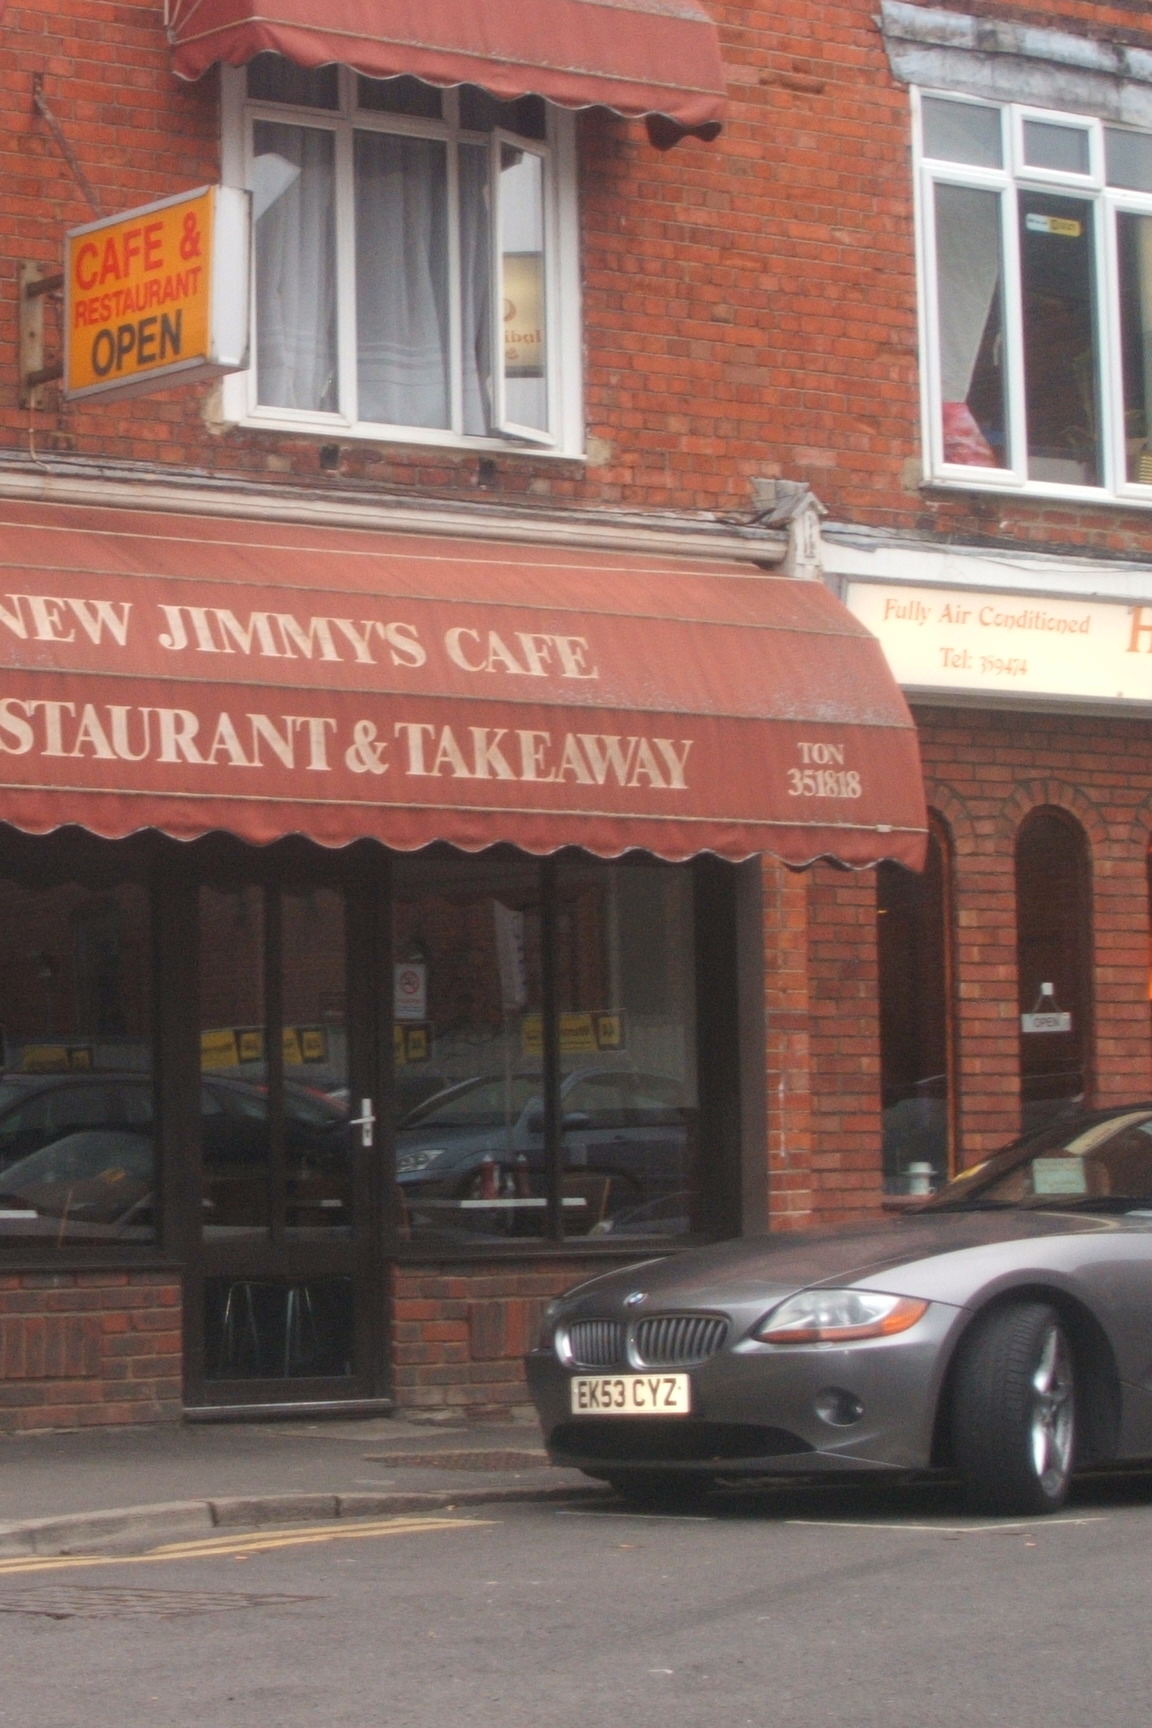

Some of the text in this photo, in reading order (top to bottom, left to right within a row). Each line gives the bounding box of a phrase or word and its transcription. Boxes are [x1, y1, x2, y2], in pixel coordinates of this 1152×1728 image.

[74, 211, 202, 291] CAFE &
[74, 266, 202, 329] RESTAURANT
[91, 309, 183, 377] OPEN
[882, 598, 1091, 635] Fully Air Conditioned
[157, 604, 427, 668] JIMMY'S
[444, 626, 600, 680] CAFE
[939, 646, 973, 669] Tel:
[345, 719, 390, 776] &
[394, 721, 695, 790] TAKEAWAY
[797, 742, 844, 765] TON
[787, 768, 862, 798] 351818
[578, 1378, 677, 1408] EK53 CYZ
